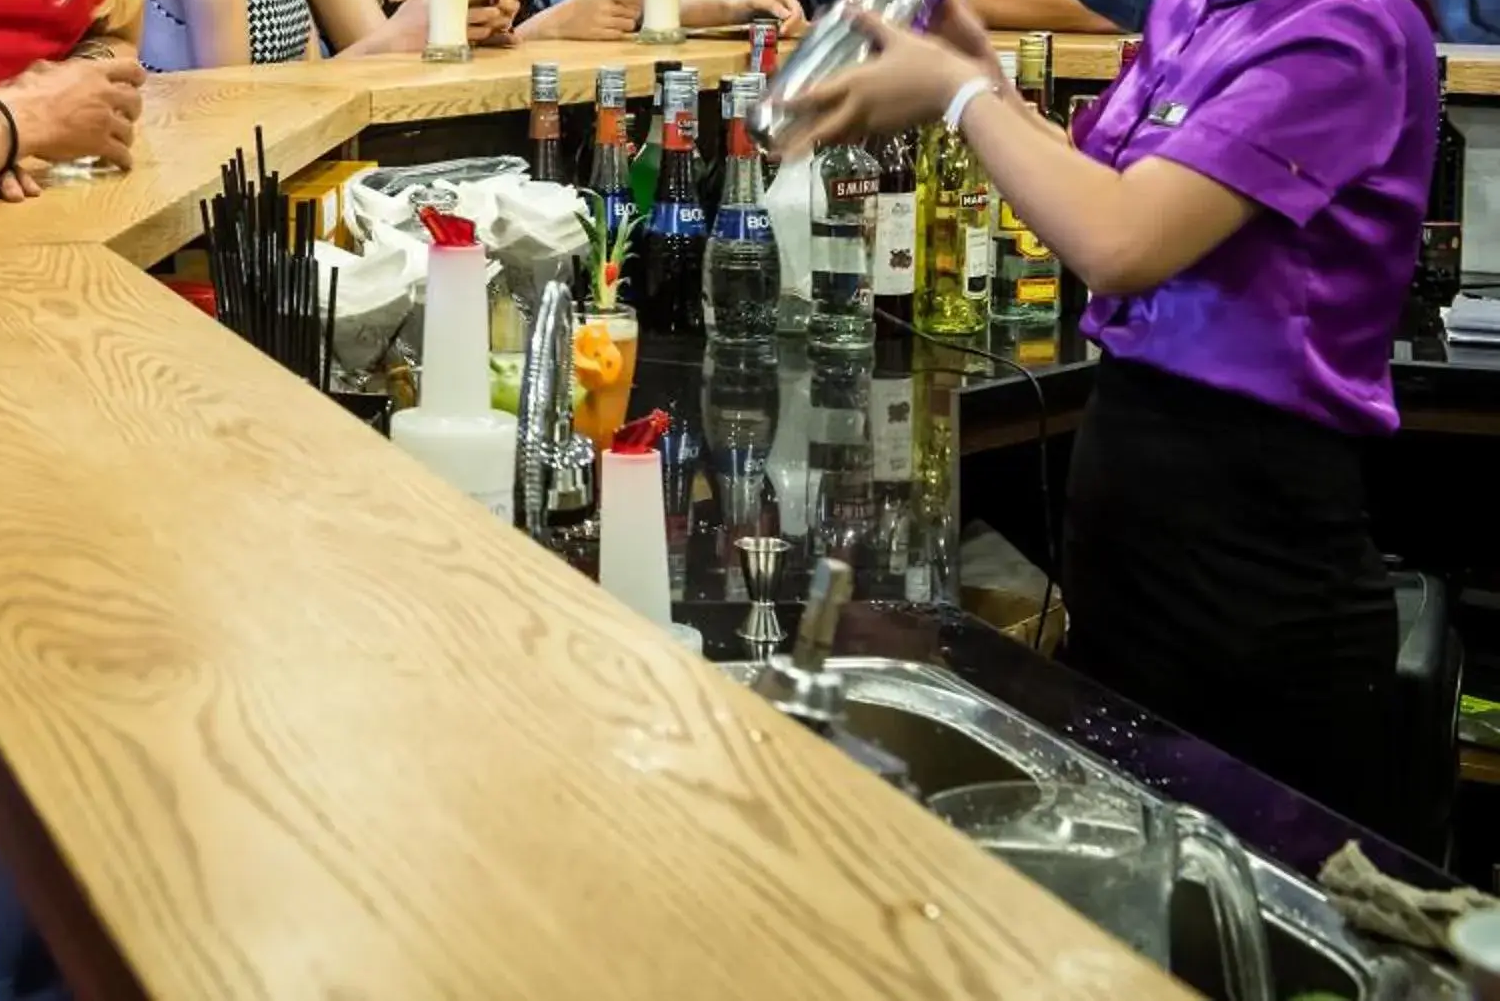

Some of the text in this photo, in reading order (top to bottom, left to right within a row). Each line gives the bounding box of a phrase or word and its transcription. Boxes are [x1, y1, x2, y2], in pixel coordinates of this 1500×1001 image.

[614, 202, 638, 216] BO
[679, 208, 703, 222] BO
[747, 216, 771, 229] BO
